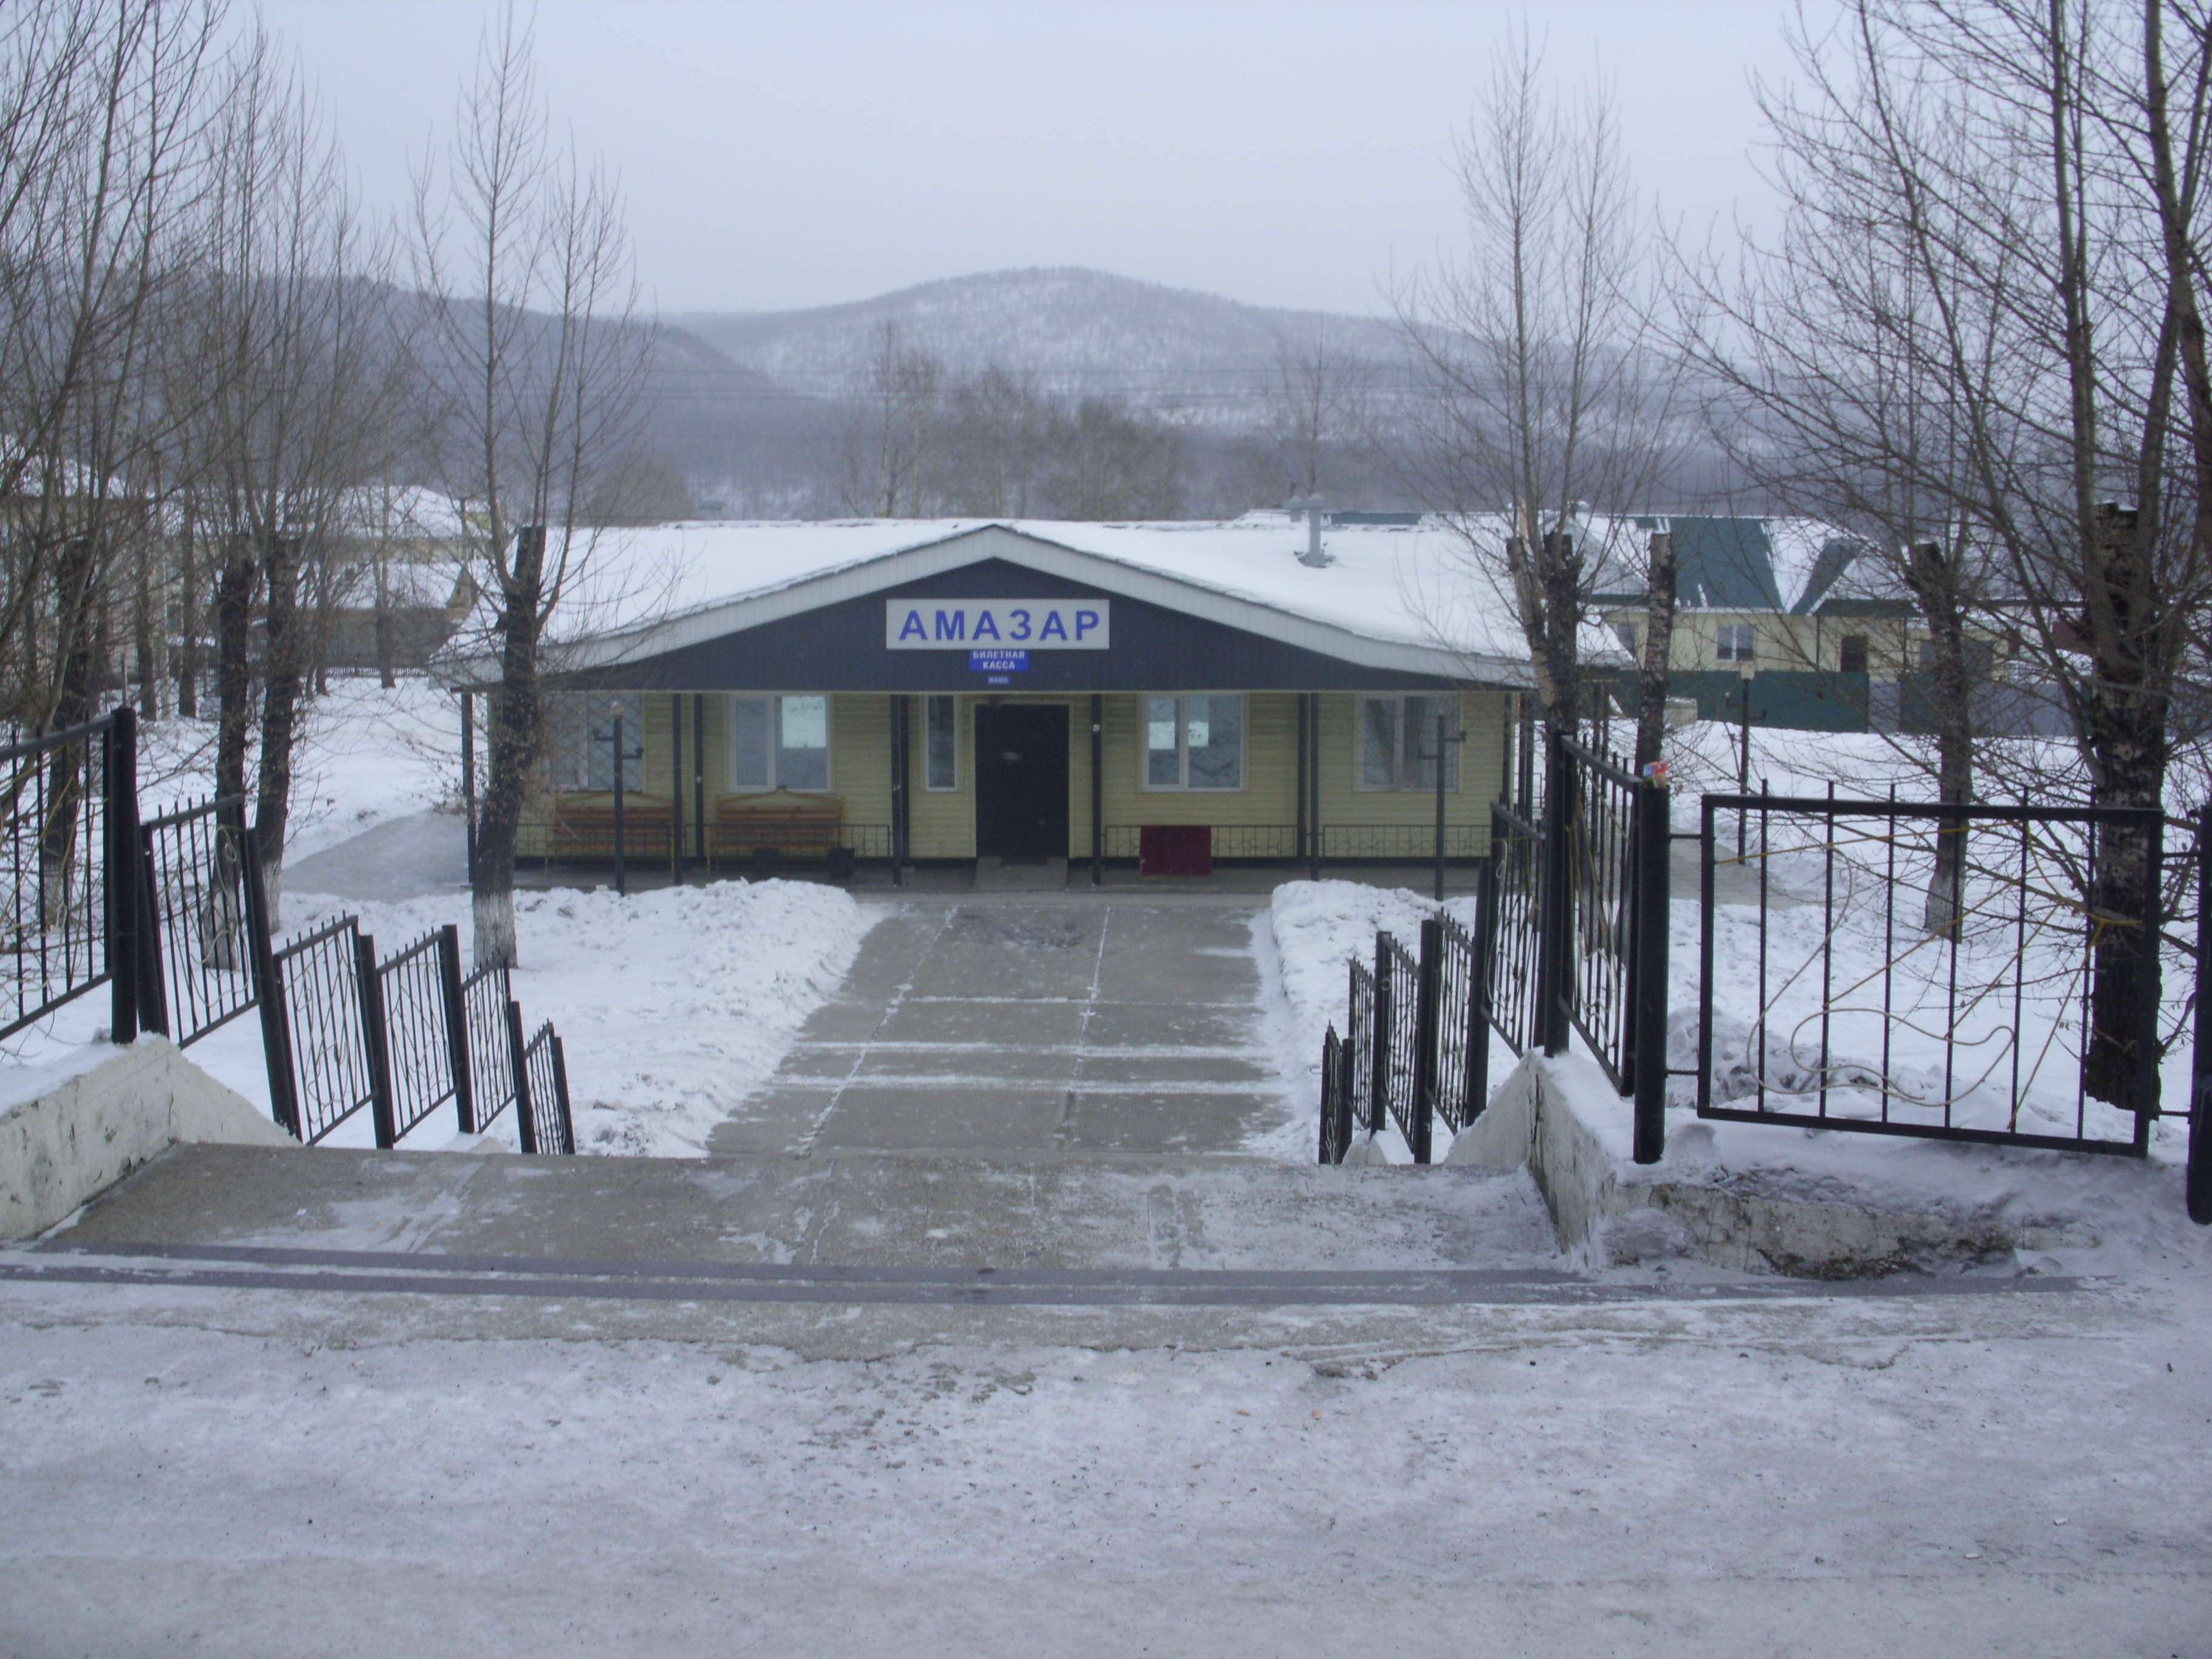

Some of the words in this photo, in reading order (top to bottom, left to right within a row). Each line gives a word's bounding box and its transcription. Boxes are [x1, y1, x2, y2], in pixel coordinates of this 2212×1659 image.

[899, 609, 1100, 641] АМАЗАР
[973, 649, 1025, 659] БИЛЕТНАЯ
[983, 660, 1015, 670] КАССА
